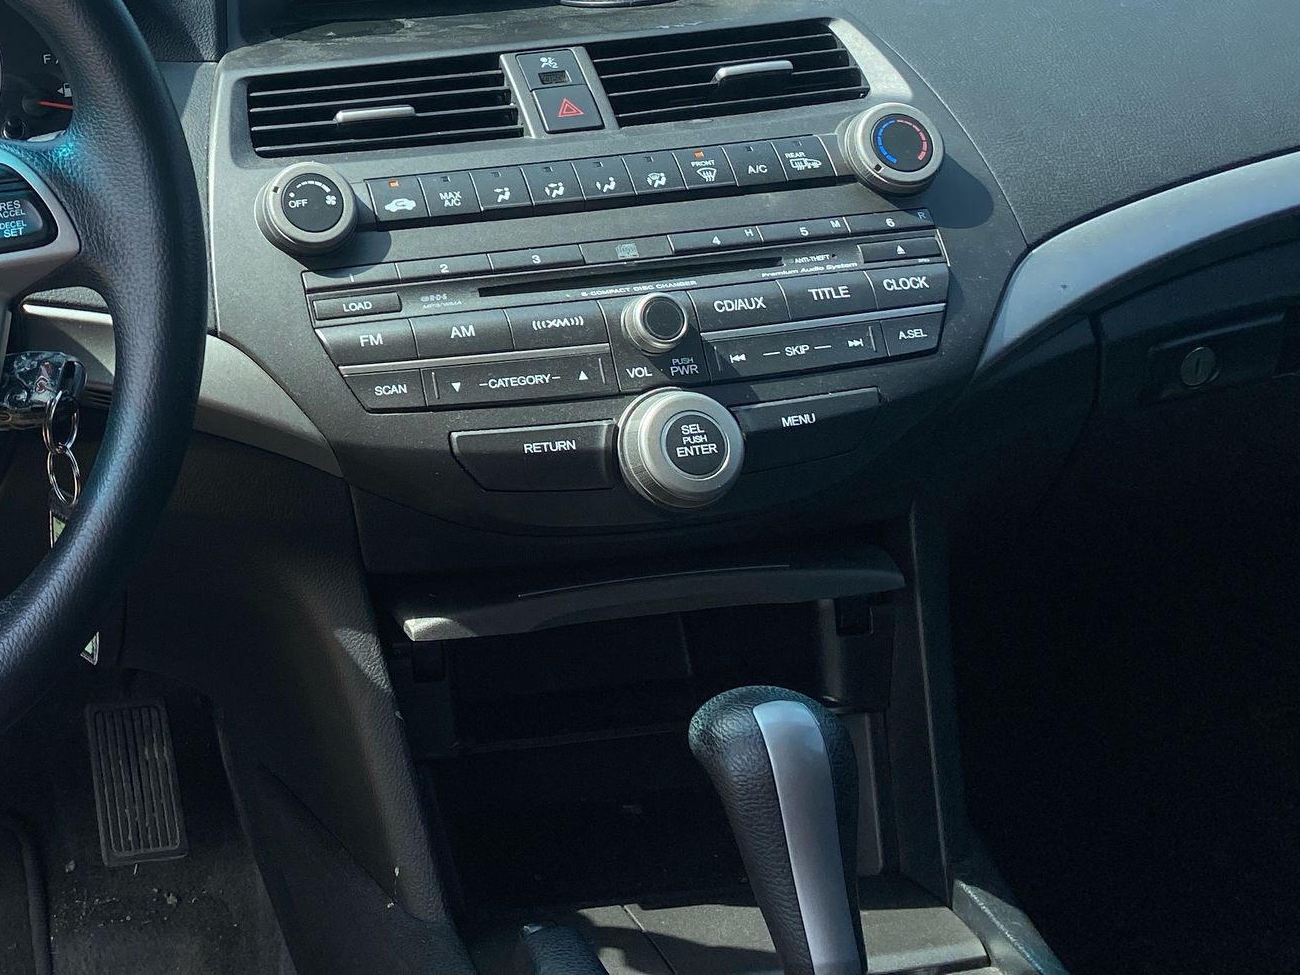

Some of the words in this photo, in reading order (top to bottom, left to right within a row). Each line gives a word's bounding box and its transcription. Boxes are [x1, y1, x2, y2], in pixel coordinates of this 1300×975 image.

[43, 54, 52, 64] F
[784, 151, 806, 159] REAR
[690, 159, 715, 168] FRONT
[747, 165, 768, 175] A/C
[439, 191, 462, 201] MAX
[0, 199, 21, 212] RES
[288, 198, 308, 209] OFF
[443, 198, 462, 208] A/C
[917, 211, 926, 220] R
[0, 220, 27, 230] DECEL
[830, 220, 841, 229] M
[885, 218, 896, 228] 6
[3, 227, 24, 238] SET
[744, 228, 754, 237] H
[799, 227, 809, 237] 5
[711, 235, 721, 245] 4
[531, 254, 541, 264] 3
[794, 254, 831, 264] ANTI-THEFT
[439, 263, 449, 273] 2
[761, 269, 799, 278] Premium
[800, 266, 825, 274] Audio
[826, 261, 858, 271] System
[633, 284, 654, 292] DISC
[655, 280, 698, 289] CHANGER
[882, 276, 930, 291] CLOCK
[808, 285, 851, 301] TITLE
[342, 301, 372, 312] LOAD
[713, 296, 767, 313] CD/AUX
[450, 325, 476, 339] AM
[898, 328, 927, 340] A.SEL
[359, 333, 383, 347] FM
[784, 344, 810, 356] SKIP
[672, 357, 694, 366] PUSH
[626, 366, 653, 379] VOL
[670, 364, 699, 376] PWR
[488, 374, 551, 389] CATEGORY
[374, 383, 408, 396] SCAN
[781, 413, 816, 428] MENU
[680, 423, 705, 435] SEL
[682, 434, 708, 445] PUSH
[523, 439, 576, 454] RETURN
[676, 443, 718, 458] ENTER
